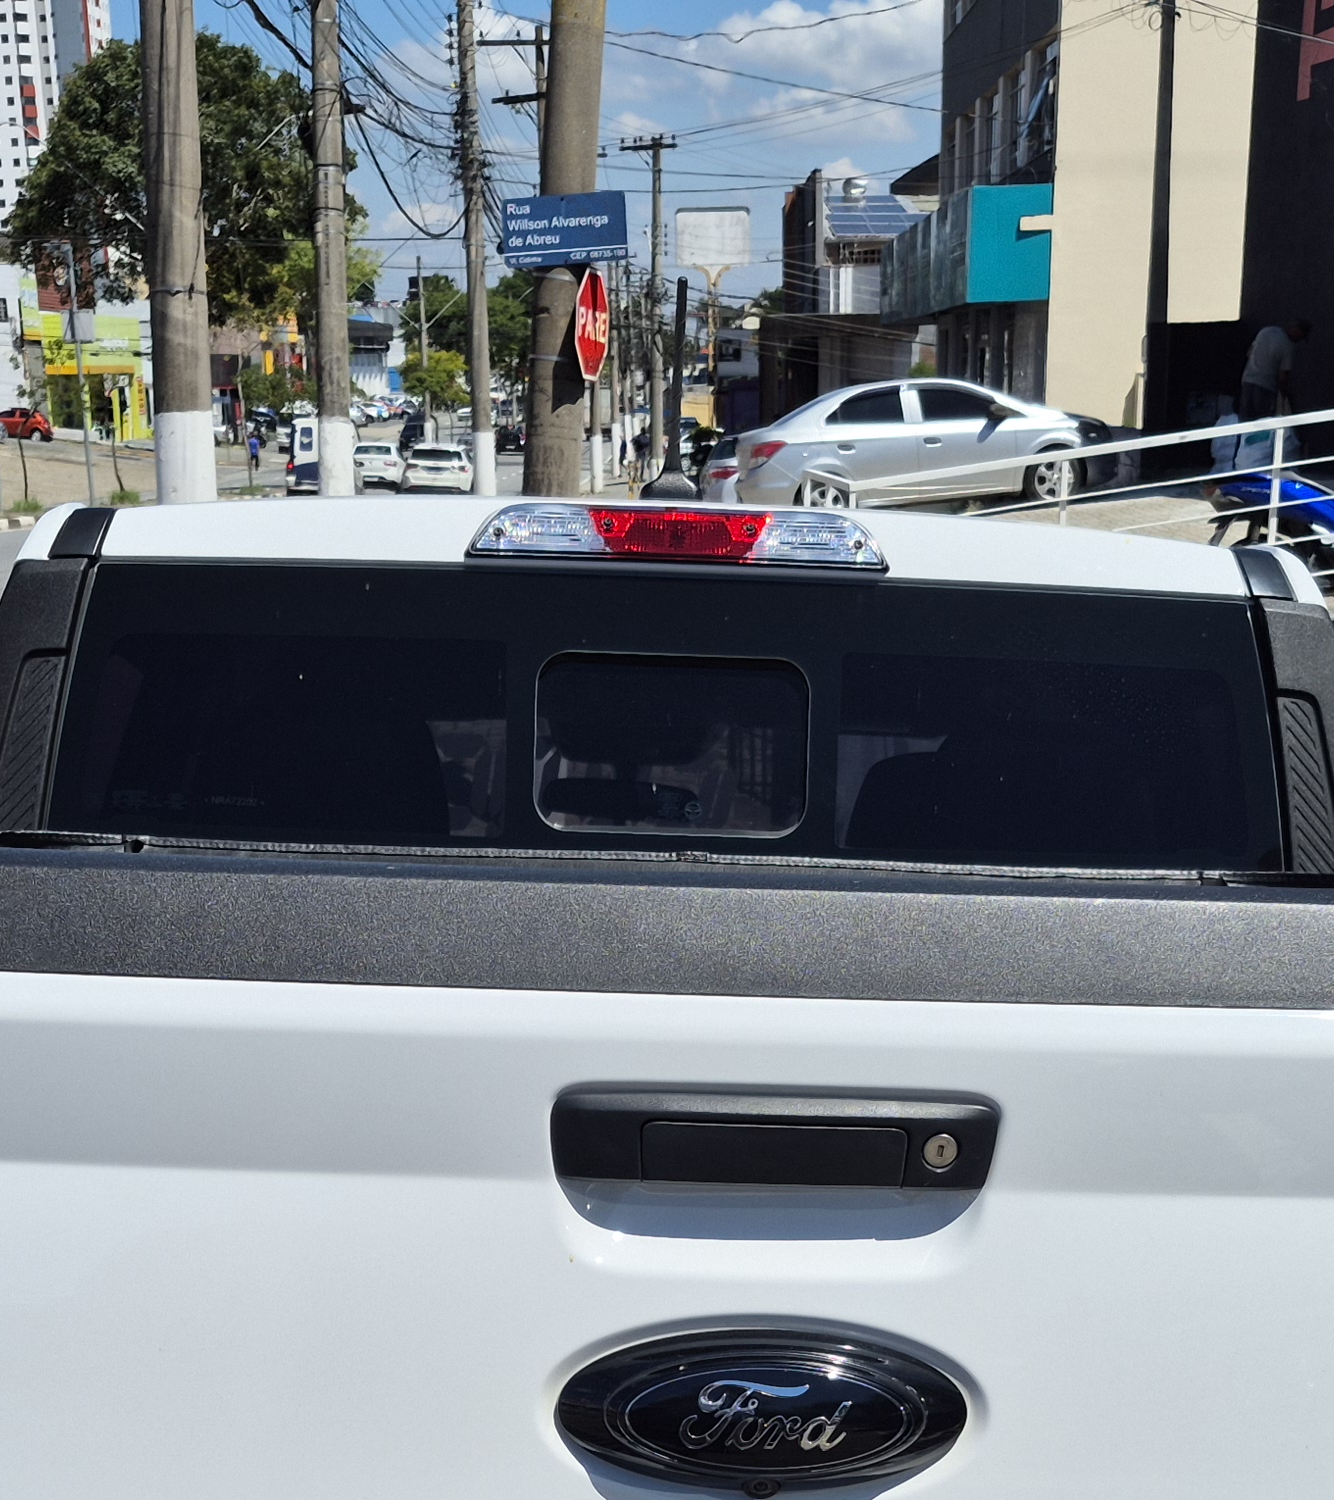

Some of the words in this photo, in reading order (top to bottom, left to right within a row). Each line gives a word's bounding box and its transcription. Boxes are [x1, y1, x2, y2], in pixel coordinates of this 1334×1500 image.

[507, 204, 530, 215] Rua
[551, 215, 609, 228] Alvarenga
[508, 235, 523, 247] de
[525, 234, 560, 246] Abreu
[578, 307, 607, 343] PARE
[679, 1379, 854, 1454] Ford
